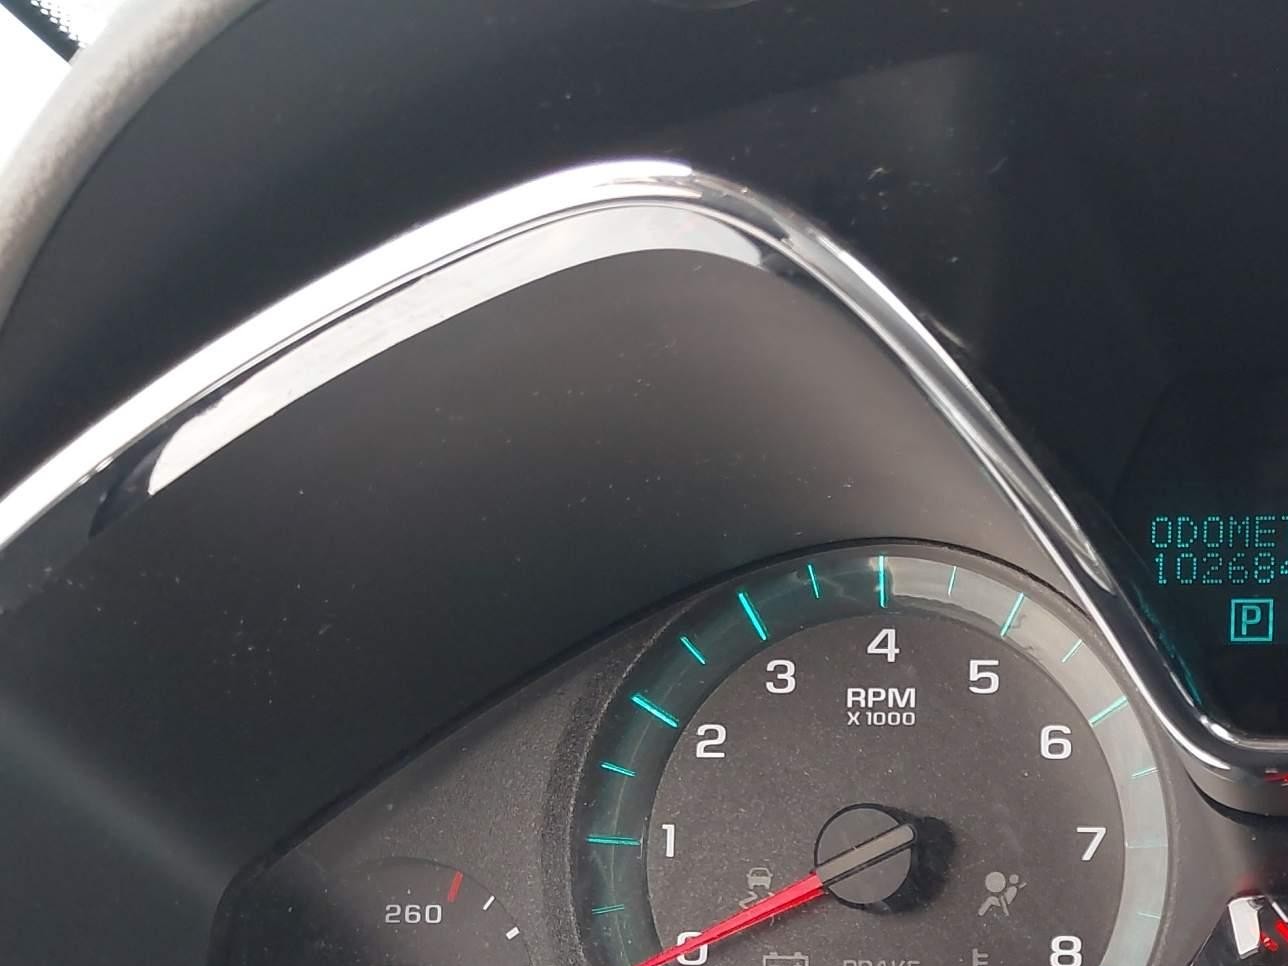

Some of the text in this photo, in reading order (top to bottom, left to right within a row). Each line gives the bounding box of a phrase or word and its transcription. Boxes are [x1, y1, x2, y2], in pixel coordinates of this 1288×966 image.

[1241, 604, 1263, 636] P
[866, 628, 900, 663] 4
[766, 659, 796, 694] 3
[968, 659, 1000, 694] 5
[846, 687, 916, 709] RPM
[847, 711, 916, 726] X 1000
[696, 724, 727, 759] 2
[1040, 725, 1073, 760] 6
[661, 824, 676, 858] 1
[1076, 827, 1106, 861] 7
[384, 904, 443, 924] 260
[676, 931, 709, 966] 0
